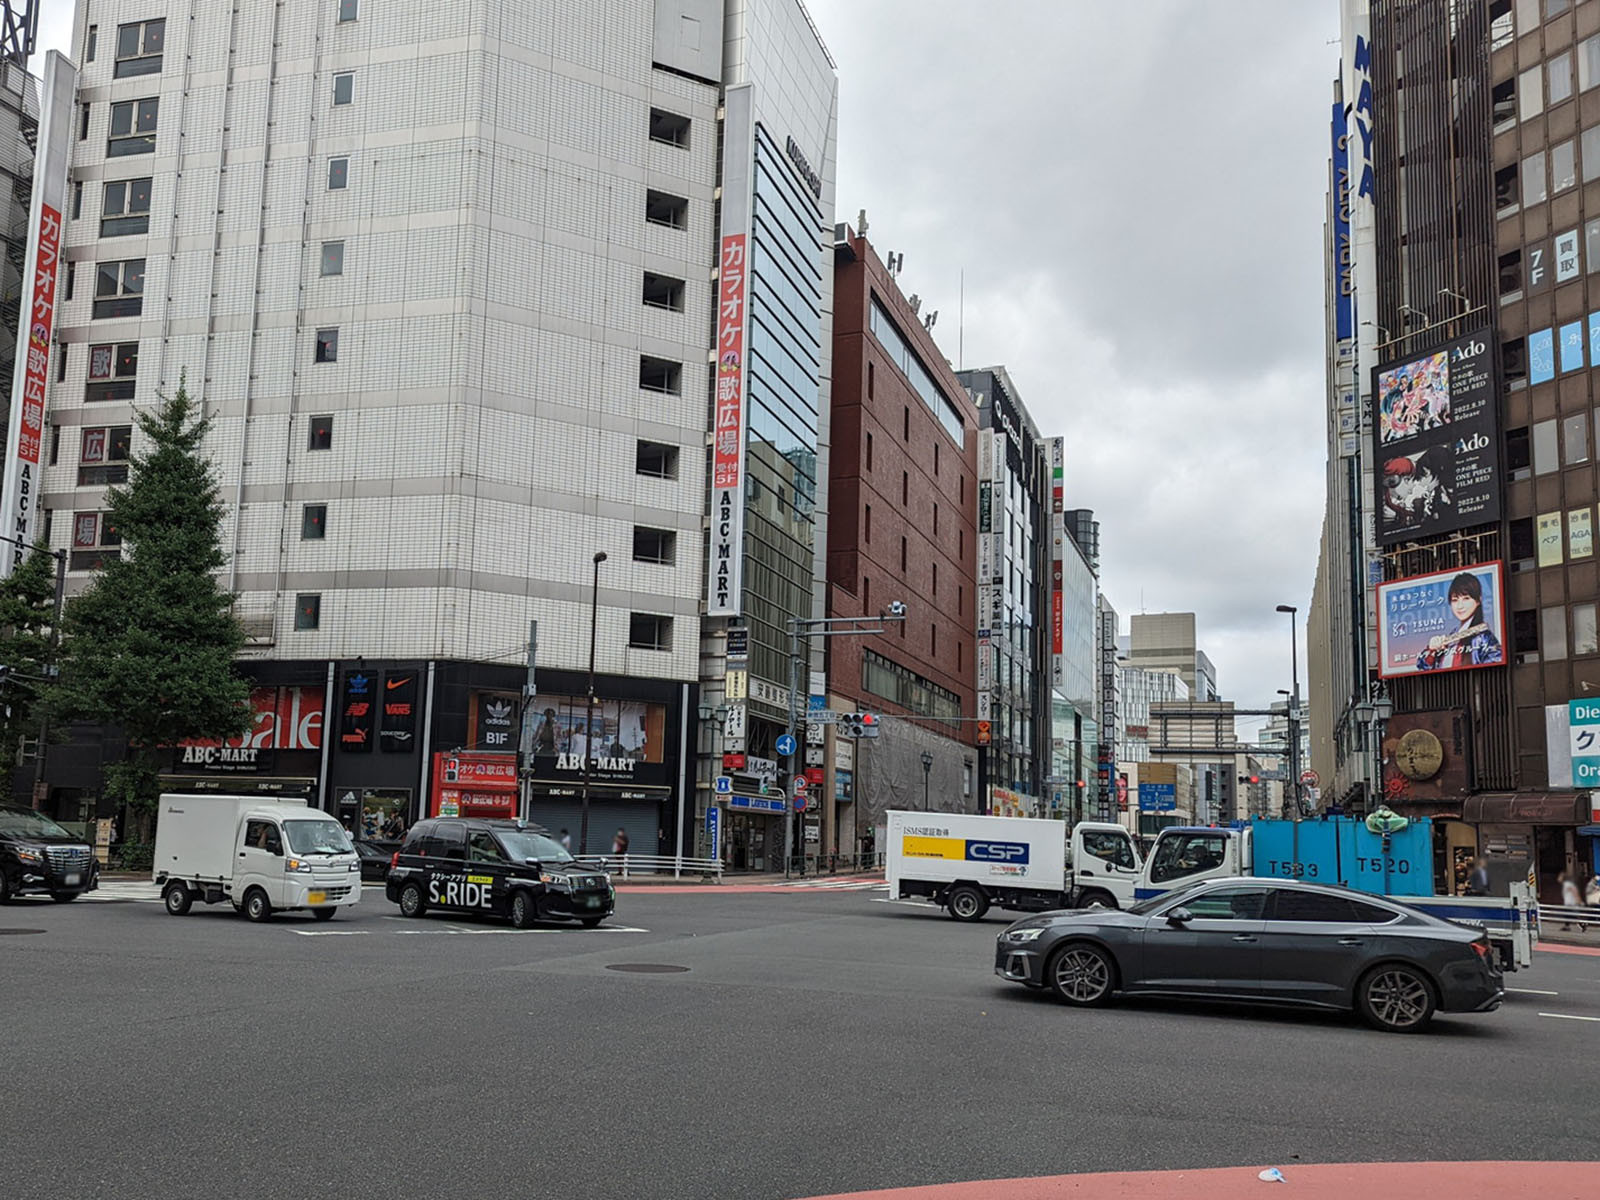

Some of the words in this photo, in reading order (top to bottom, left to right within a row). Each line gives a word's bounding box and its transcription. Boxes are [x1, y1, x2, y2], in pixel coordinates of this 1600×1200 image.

[1355, 34, 1375, 206] MAYA
[1559, 239, 1576, 273] 買取
[34, 212, 59, 321] カラオケ
[720, 241, 744, 347] カラオケ
[1452, 340, 1485, 363] Ado
[91, 349, 111, 378] 歌
[22, 347, 47, 430] 歌広場
[1452, 378, 1467, 389] ONE
[1468, 372, 1489, 385] PIECE
[1453, 385, 1469, 396] FILM
[1471, 381, 1486, 392] RED
[717, 376, 739, 456] 歌広場
[1454, 409, 1480, 421] Release
[19, 447, 38, 458] 5F
[85, 433, 104, 461] 広
[1455, 433, 1489, 455] Ado
[716, 462, 738, 474] 受付
[1456, 470, 1471, 480] ONE
[1472, 465, 1493, 477] PIECE
[716, 474, 736, 484] 5F
[1456, 477, 1473, 488] FILM
[1475, 473, 1490, 484] RED
[1458, 503, 1485, 515] Release
[12, 464, 31, 572] ABC-MAR
[1571, 529, 1591, 539] AGA
[717, 490, 731, 608] ABC-MART
[1391, 597, 1445, 612] リレーワーク
[1412, 618, 1444, 629] TSUNA
[384, 703, 411, 716] VANS
[485, 717, 510, 726] adidas
[486, 732, 508, 745] B1F
[182, 745, 257, 764] ABC-MART
[969, 843, 1025, 860] CSP
[1356, 857, 1410, 874] T520
[429, 872, 467, 882] タクシーアプリ
[429, 880, 493, 908] S.RIDE
